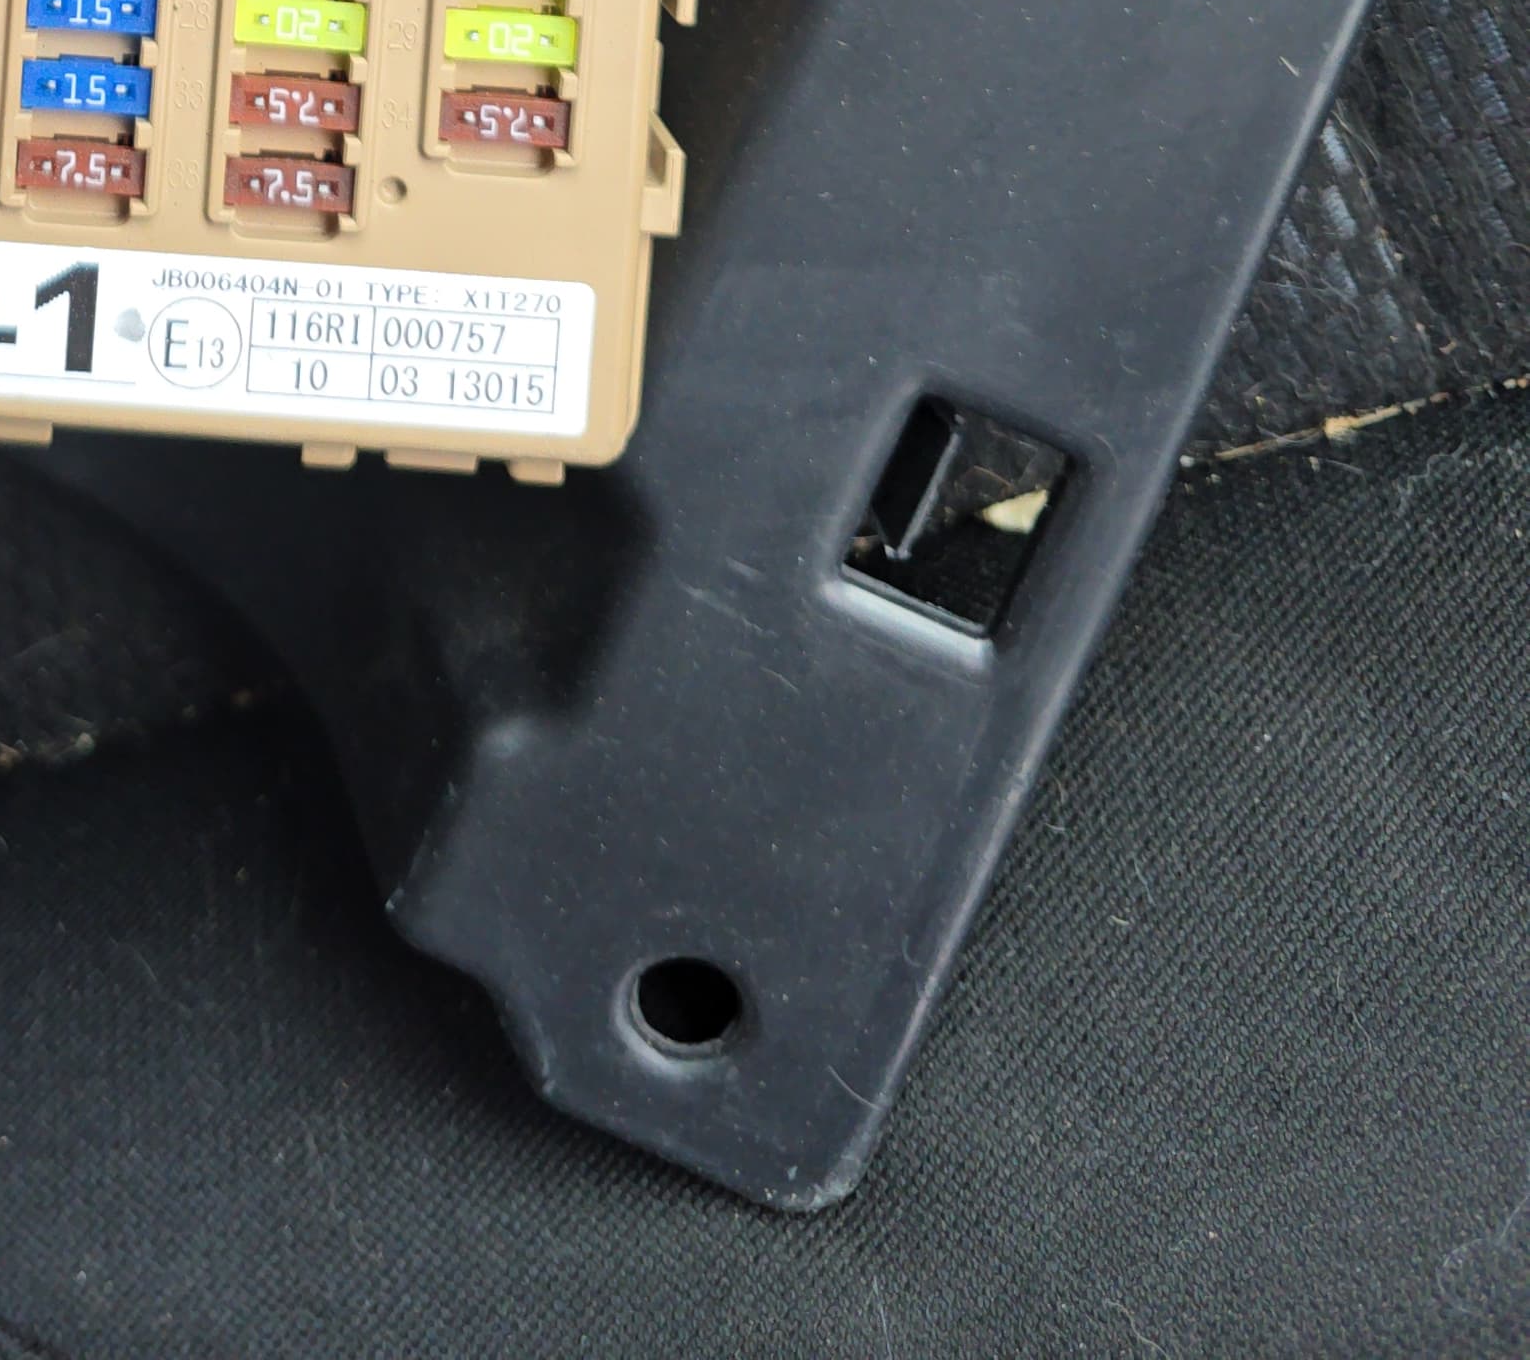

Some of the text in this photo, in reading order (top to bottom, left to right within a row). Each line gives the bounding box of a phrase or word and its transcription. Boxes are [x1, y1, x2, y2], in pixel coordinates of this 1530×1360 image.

[181, 1, 210, 29] 28
[276, 8, 320, 40] 20
[389, 19, 418, 49] 29
[488, 23, 533, 55] 20
[62, 73, 106, 105] 15
[269, 89, 320, 122] 7.5
[383, 99, 412, 127] 34
[481, 105, 531, 139] 7.5
[56, 151, 106, 184] 7.5
[262, 170, 313, 204] 7.5
[365, 281, 440, 305] TYPE:
[463, 288, 562, 314] X1T270
[382, 315, 507, 356] 000757
[292, 356, 330, 392] 10
[379, 363, 546, 407] 03 13015
